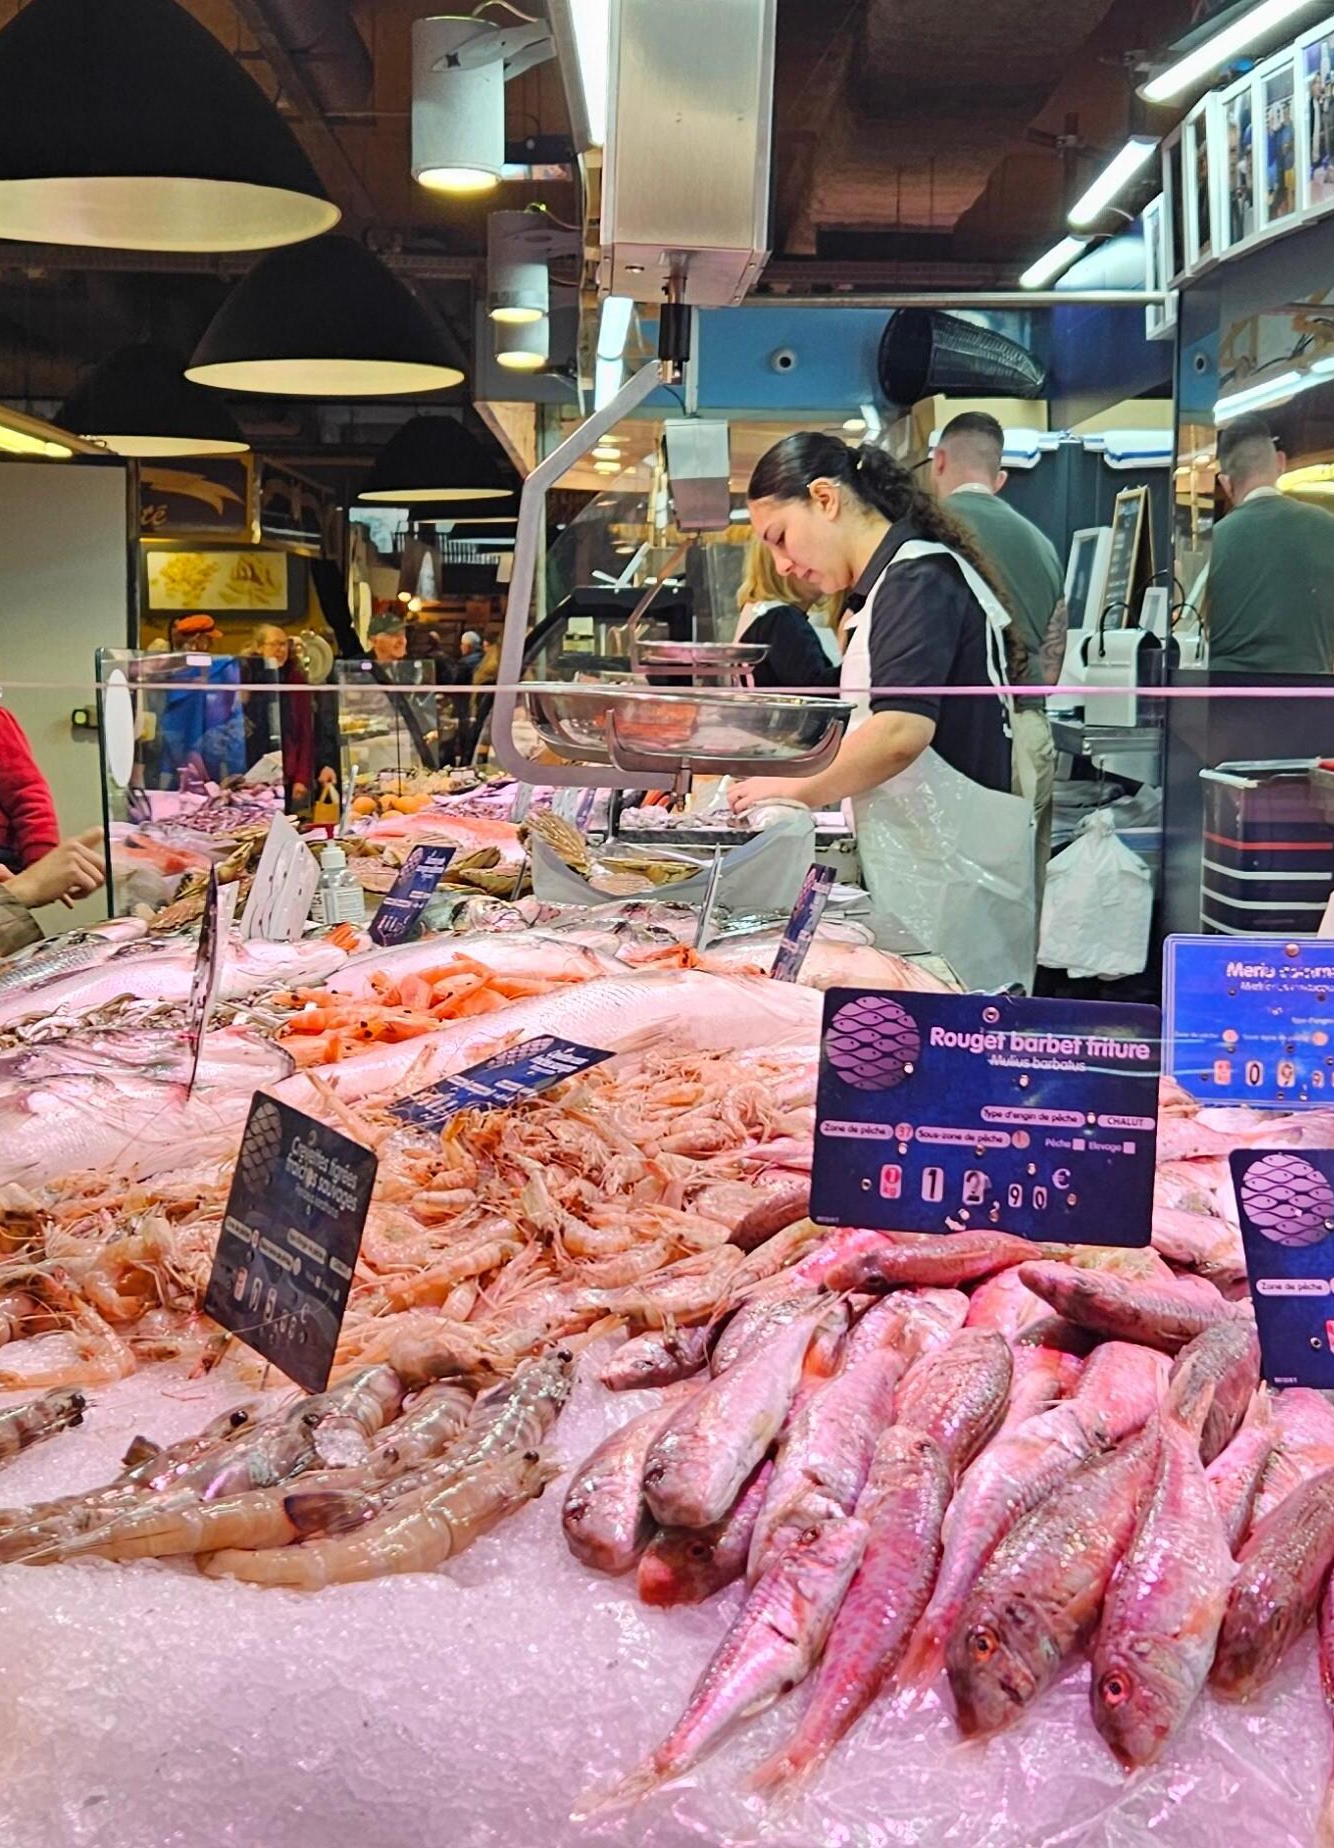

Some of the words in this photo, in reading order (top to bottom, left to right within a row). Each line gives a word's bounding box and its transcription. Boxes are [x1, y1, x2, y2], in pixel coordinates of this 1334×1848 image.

[929, 1026, 1007, 1054] Rouget
[1009, 1031, 1083, 1056] barbet
[1085, 1037, 1151, 1060] friture
[983, 1109, 1002, 1119] Type
[1004, 1109, 1038, 1122] d'engin
[1039, 1112, 1050, 1121] de
[1051, 1111, 1078, 1124] pêche
[824, 1122, 846, 1132] Zone
[847, 1124, 859, 1133] de
[860, 1124, 886, 1135] pêche
[964, 1132, 975, 1141] de
[976, 1133, 1003, 1144] pêche
[1051, 1167, 1071, 1190] €
[317, 1176, 359, 1213] sauvages
